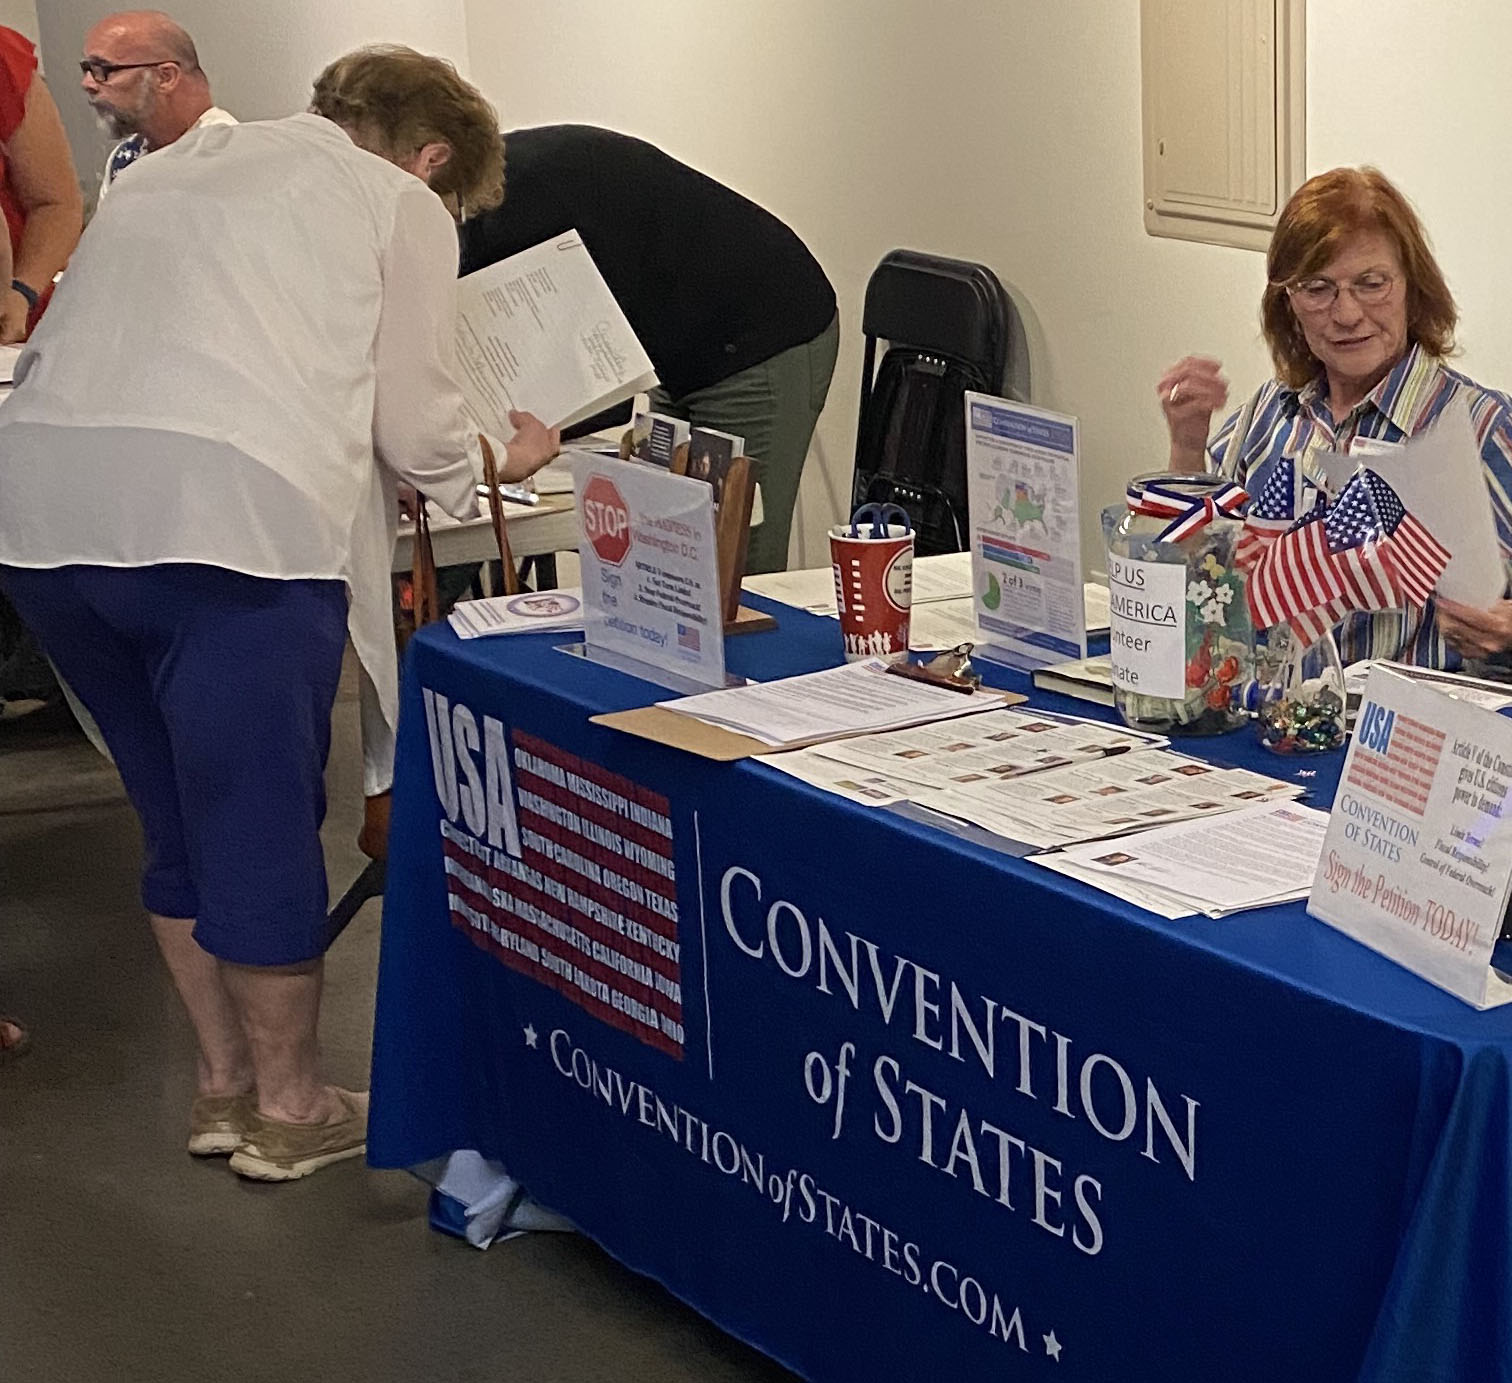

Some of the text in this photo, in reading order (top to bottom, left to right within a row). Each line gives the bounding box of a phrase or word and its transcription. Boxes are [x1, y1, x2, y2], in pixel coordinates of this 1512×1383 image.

[585, 500, 628, 539] STOP
[600, 567, 622, 590] Sign
[1009, 575, 1017, 586] of
[1125, 566, 1145, 586] US
[422, 686, 522, 859] USA
[1359, 701, 1395, 756] USA
[514, 747, 673, 840] OKLAHOMA MISSISSIPPI INDIANA
[517, 787, 676, 882] WASHINGTON ILLINOIS WYOMING
[1340, 794, 1420, 847] CONVENTION
[521, 826, 554, 860] SOUTH
[554, 842, 601, 885] CAROLINA
[602, 867, 644, 905] OREGON
[644, 888, 679, 923] TEXAS
[1345, 822, 1402, 863] OF STATES
[543, 875, 567, 904] NEW
[567, 887, 625, 936] HAMPSHIRE
[625, 917, 681, 964] KENTUCKY
[1323, 849, 1352, 894] Sign
[1350, 863, 1373, 900] the
[1371, 874, 1422, 926] Petition
[1421, 899, 1481, 956] TODAY!
[514, 898, 592, 957] MASSACHUSETTS
[592, 939, 654, 988] CALIFORNIA
[654, 970, 682, 1005] IOWA
[541, 947, 573, 982] SOUTH
[573, 965, 610, 1004] DAKOTA
[611, 988, 660, 1030] GEORGIA
[660, 1011, 685, 1045] OHIO
[721, 866, 1200, 1182] CONVENTION
[804, 1041, 1104, 1256] of STATES
